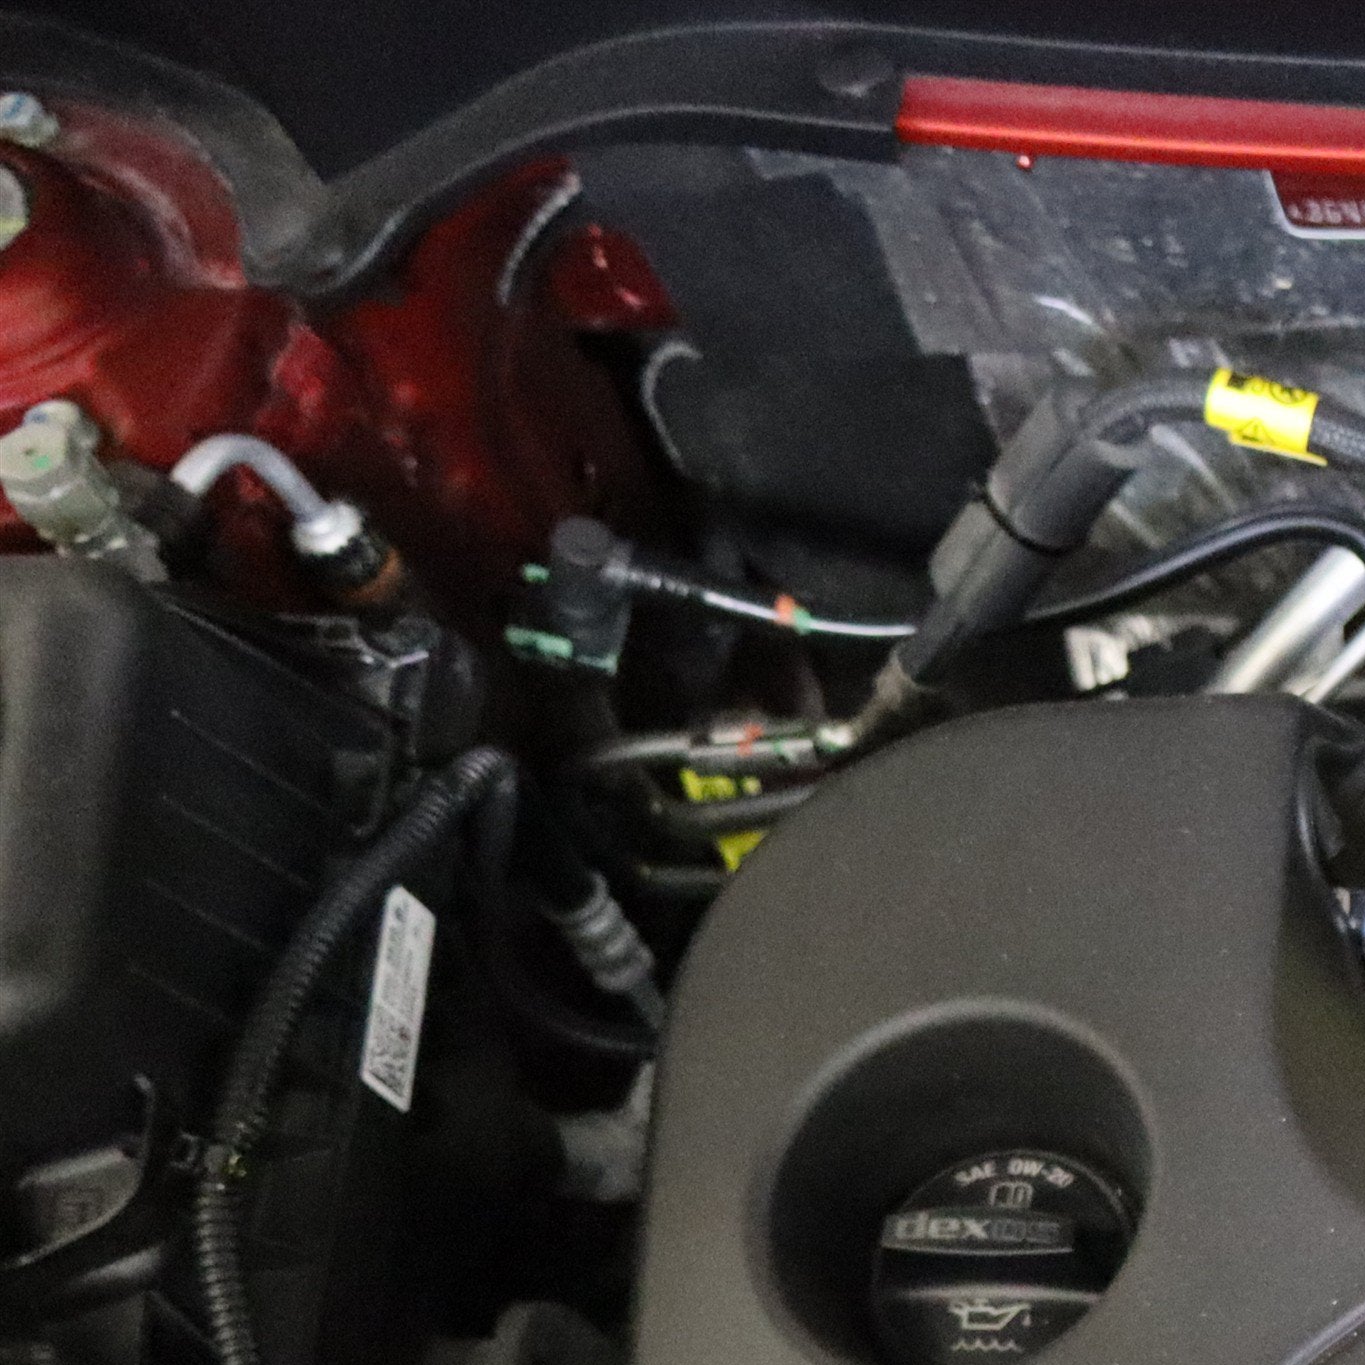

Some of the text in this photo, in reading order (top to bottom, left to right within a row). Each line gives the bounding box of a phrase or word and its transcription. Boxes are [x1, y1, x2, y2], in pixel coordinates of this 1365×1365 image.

[953, 1157, 1075, 1188] SAE 0W-20
[893, 1210, 1061, 1242] dexos
